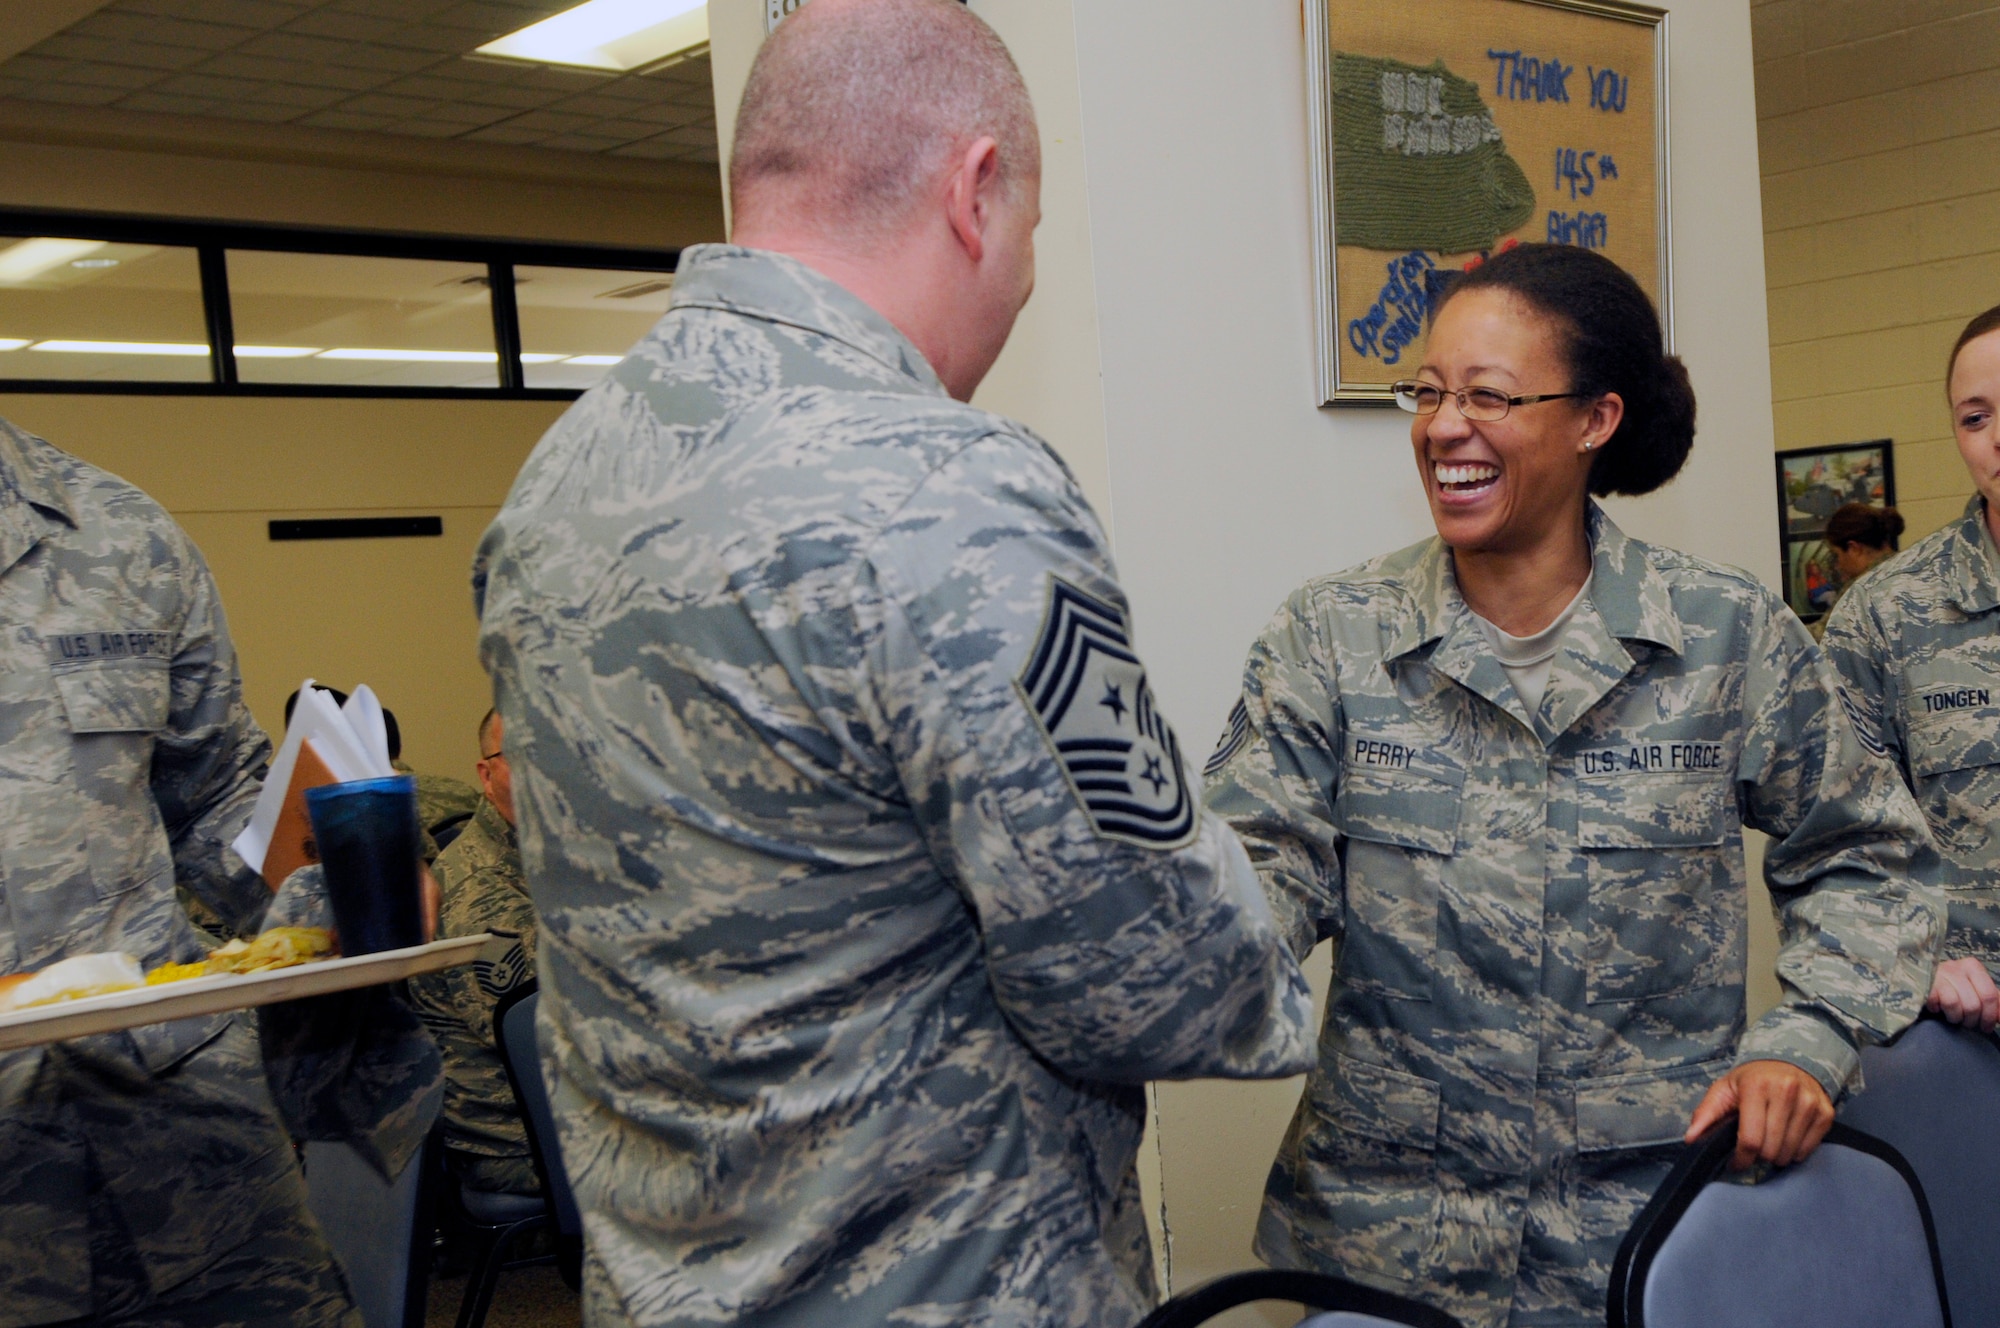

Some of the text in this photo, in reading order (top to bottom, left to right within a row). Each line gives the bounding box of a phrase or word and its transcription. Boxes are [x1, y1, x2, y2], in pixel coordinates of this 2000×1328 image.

[1488, 48, 1574, 103] THANK
[1588, 65, 1629, 113] YOU
[1923, 689, 1990, 713] TONGEN
[1354, 739, 1416, 770] PERRY
[1584, 744, 1721, 774] U.S. AIR FORCE
